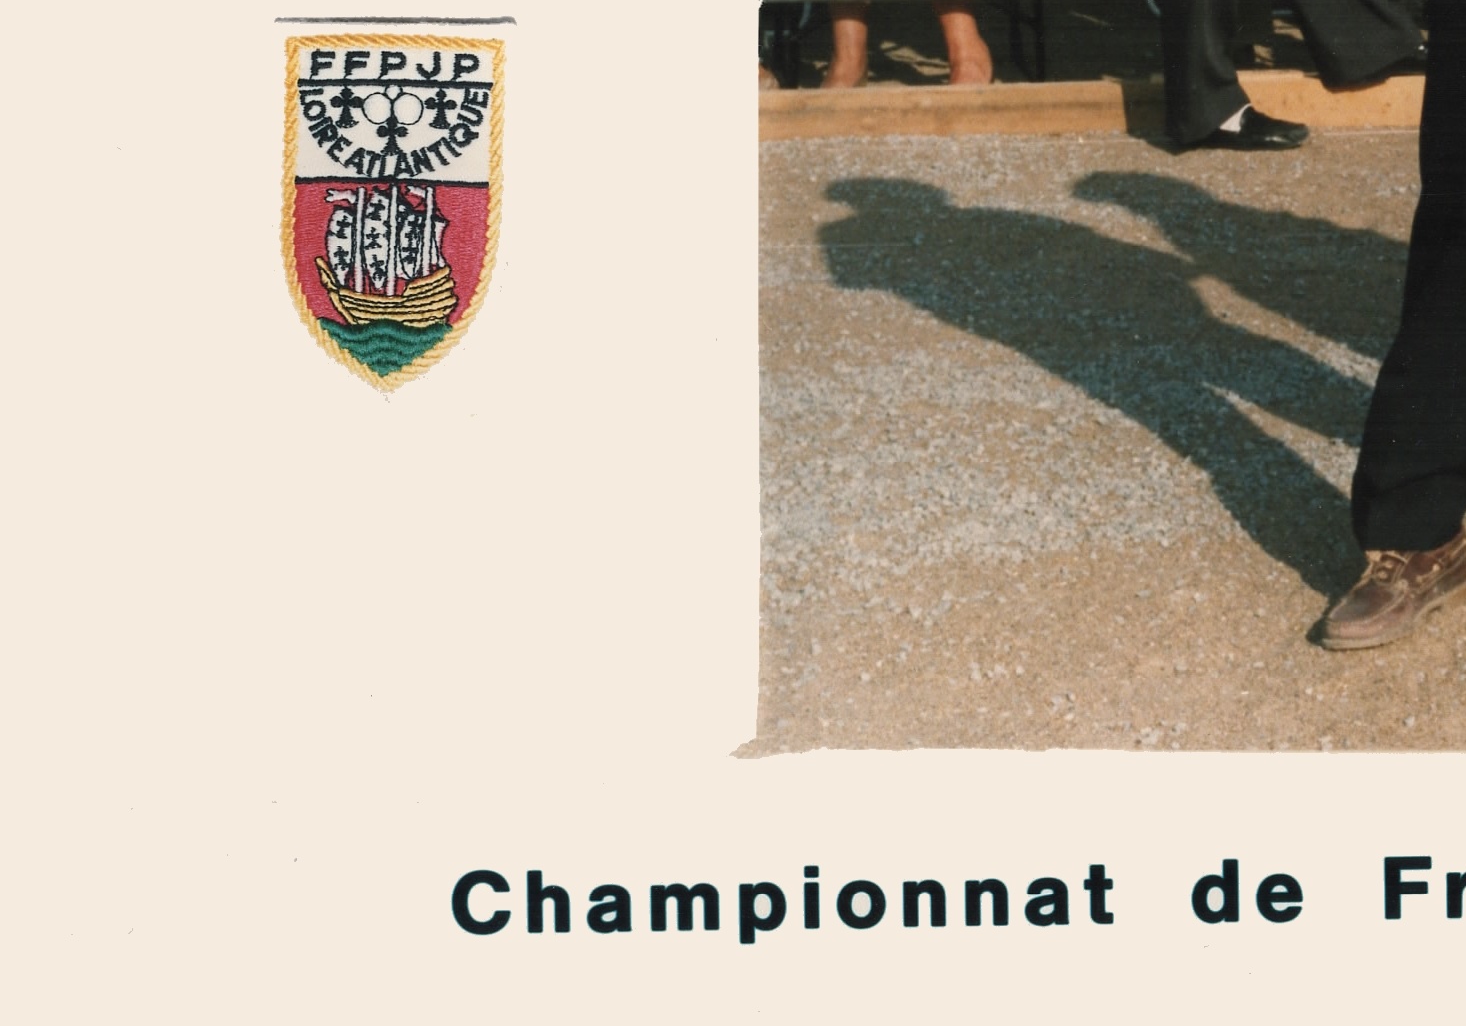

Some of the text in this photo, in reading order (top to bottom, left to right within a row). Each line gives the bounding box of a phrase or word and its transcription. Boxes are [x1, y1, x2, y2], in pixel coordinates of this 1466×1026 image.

[309, 50, 480, 79] FFPJP
[451, 863, 1114, 945] Championnat
[1191, 858, 1304, 925] de
